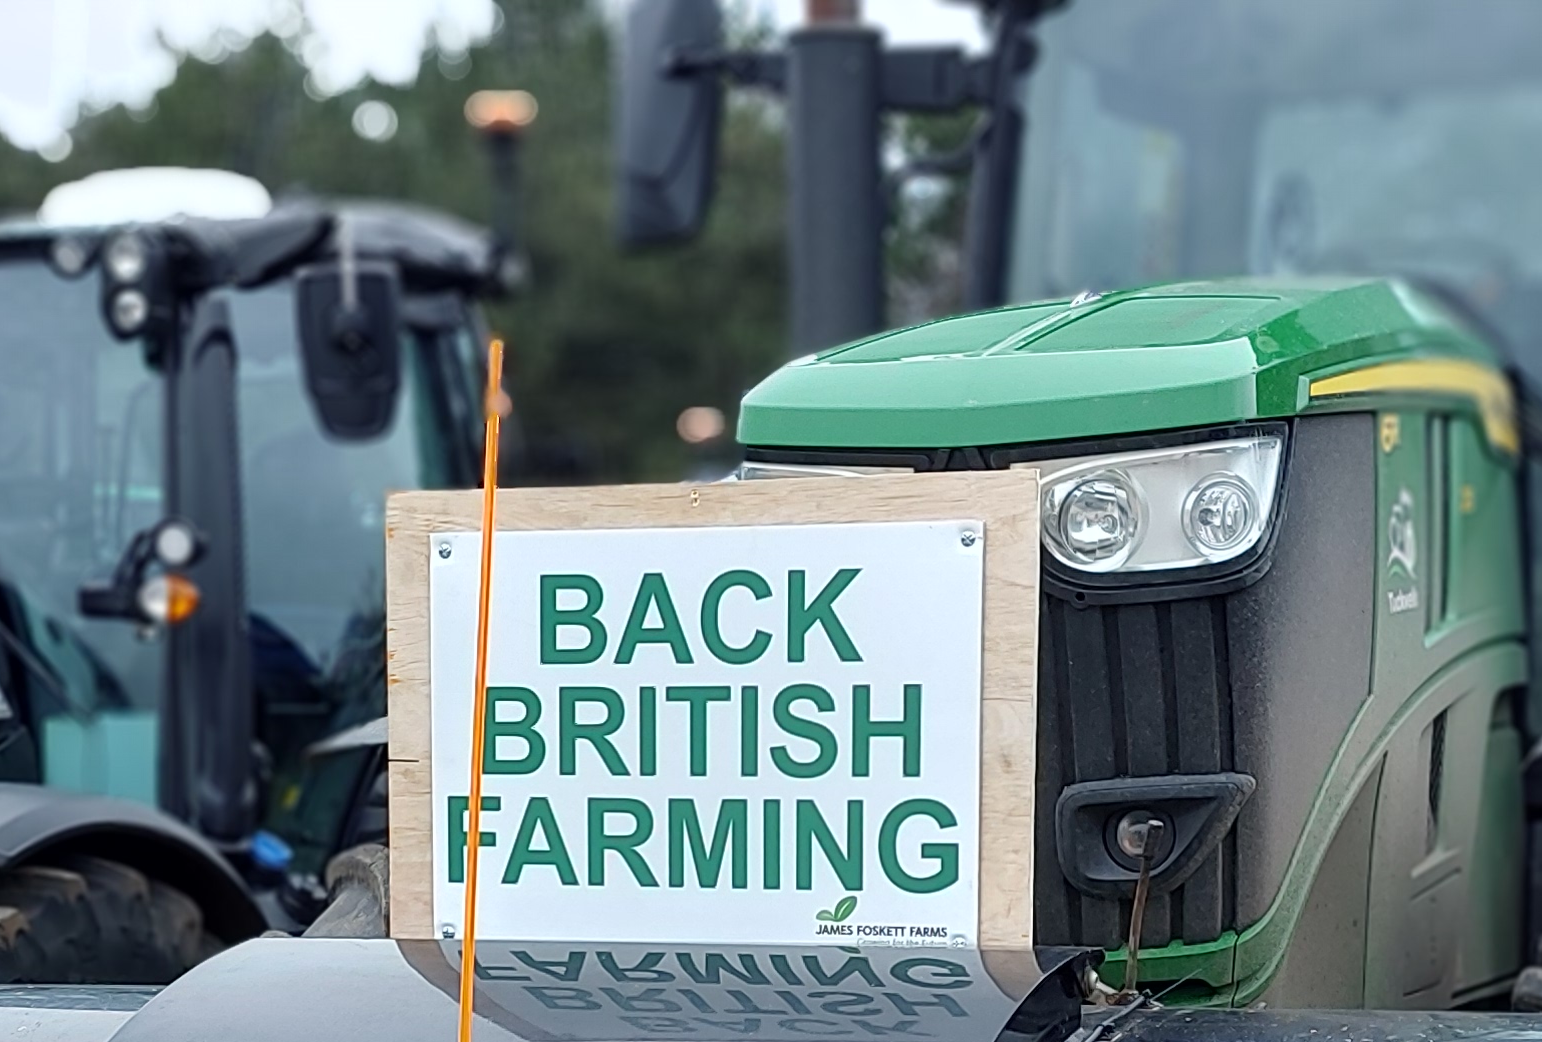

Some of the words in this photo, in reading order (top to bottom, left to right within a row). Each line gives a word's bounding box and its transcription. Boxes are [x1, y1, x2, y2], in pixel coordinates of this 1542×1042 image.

[539, 568, 863, 666] BACK
[481, 683, 923, 779] BRITISH
[446, 795, 960, 895] FARMING
[815, 924, 853, 935] JAMES
[856, 925, 907, 937] FOSKETT
[909, 926, 948, 938] FARMS
